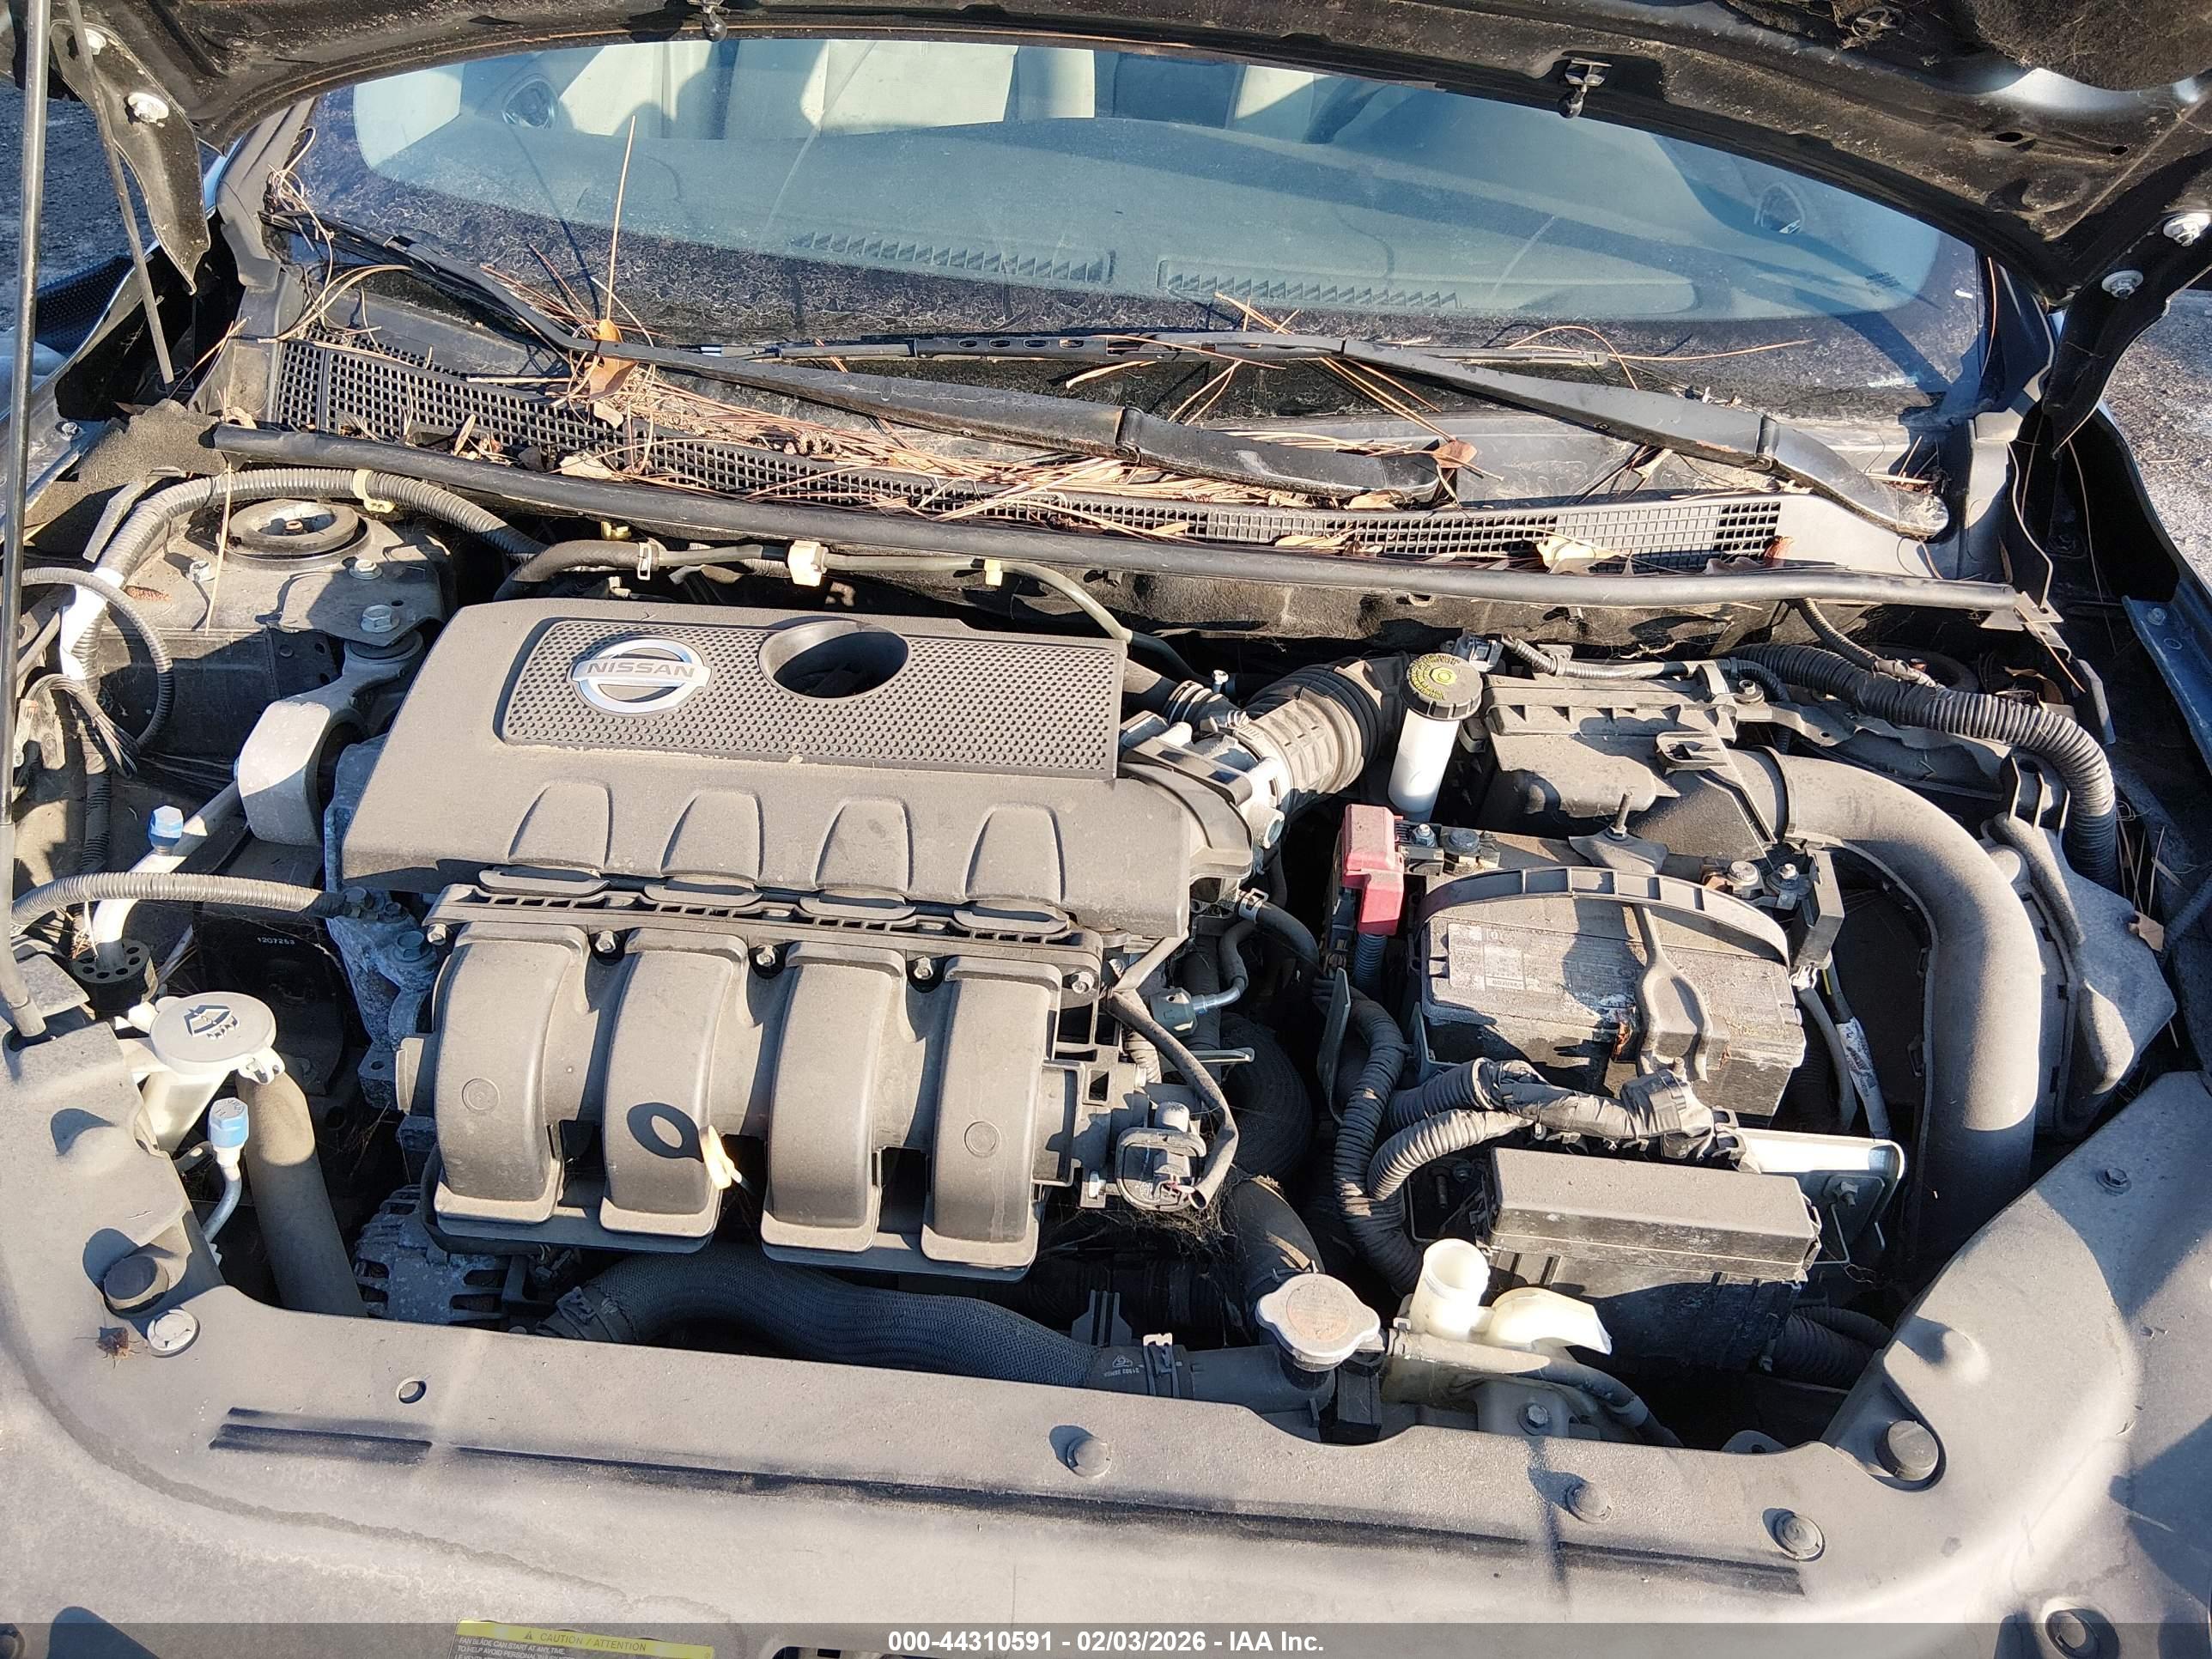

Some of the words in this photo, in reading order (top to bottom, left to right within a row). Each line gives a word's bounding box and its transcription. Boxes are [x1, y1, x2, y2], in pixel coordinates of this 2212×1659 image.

[586, 661, 696, 678] NISSAN
[459, 1637, 472, 1645] FAN
[472, 1638, 492, 1647] BLADE
[494, 1640, 507, 1649] CAN
[507, 1642, 527, 1650] START
[540, 1632, 583, 1644] CAUTION
[593, 1638, 647, 1652] ATTENTION
[483, 1648, 503, 1656] AVOID
[503, 1650, 536, 1659] PERSONAL
